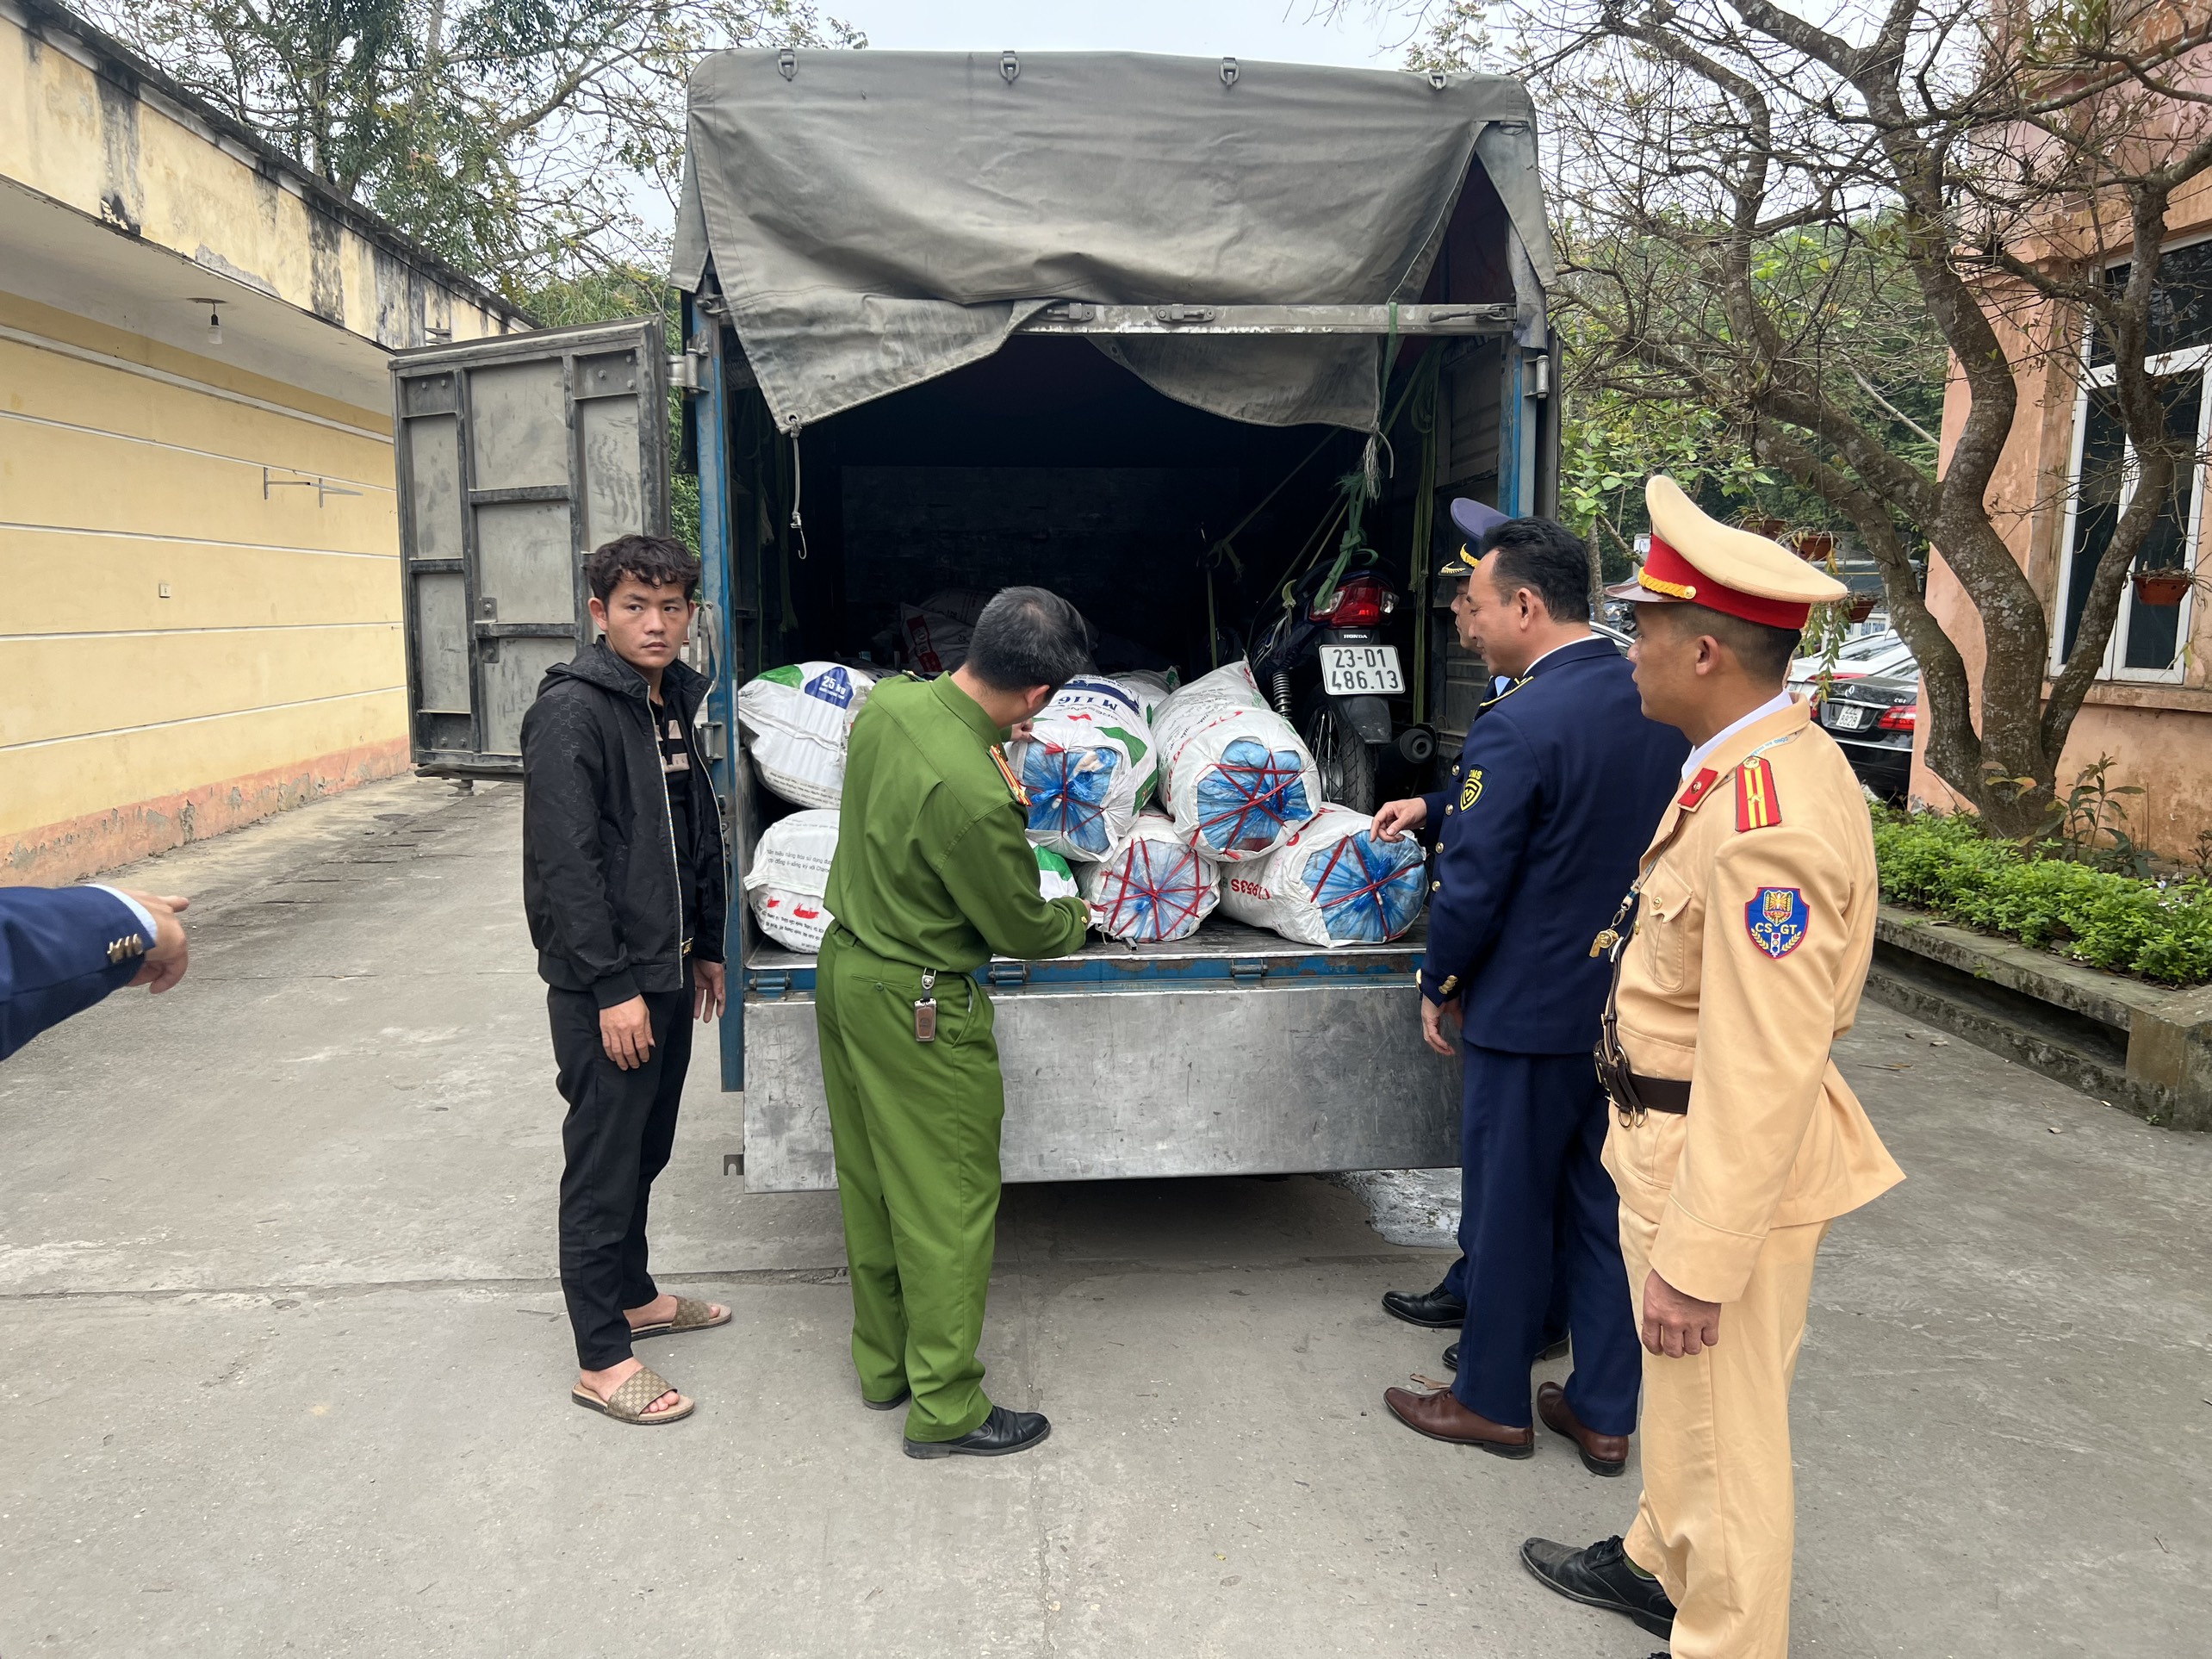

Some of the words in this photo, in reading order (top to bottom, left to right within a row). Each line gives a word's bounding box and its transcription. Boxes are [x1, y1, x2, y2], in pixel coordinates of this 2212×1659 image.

[1333, 649, 1386, 668] 23-D1
[822, 675, 836, 690] 25
[836, 683, 846, 695] kg
[1332, 670, 1399, 690] 486.13
[1058, 696, 1094, 705] 116
[1102, 699, 1118, 711] M
[1838, 714, 1858, 727] 8828
[1755, 922, 1774, 934] CS
[1780, 923, 1798, 935] GT
